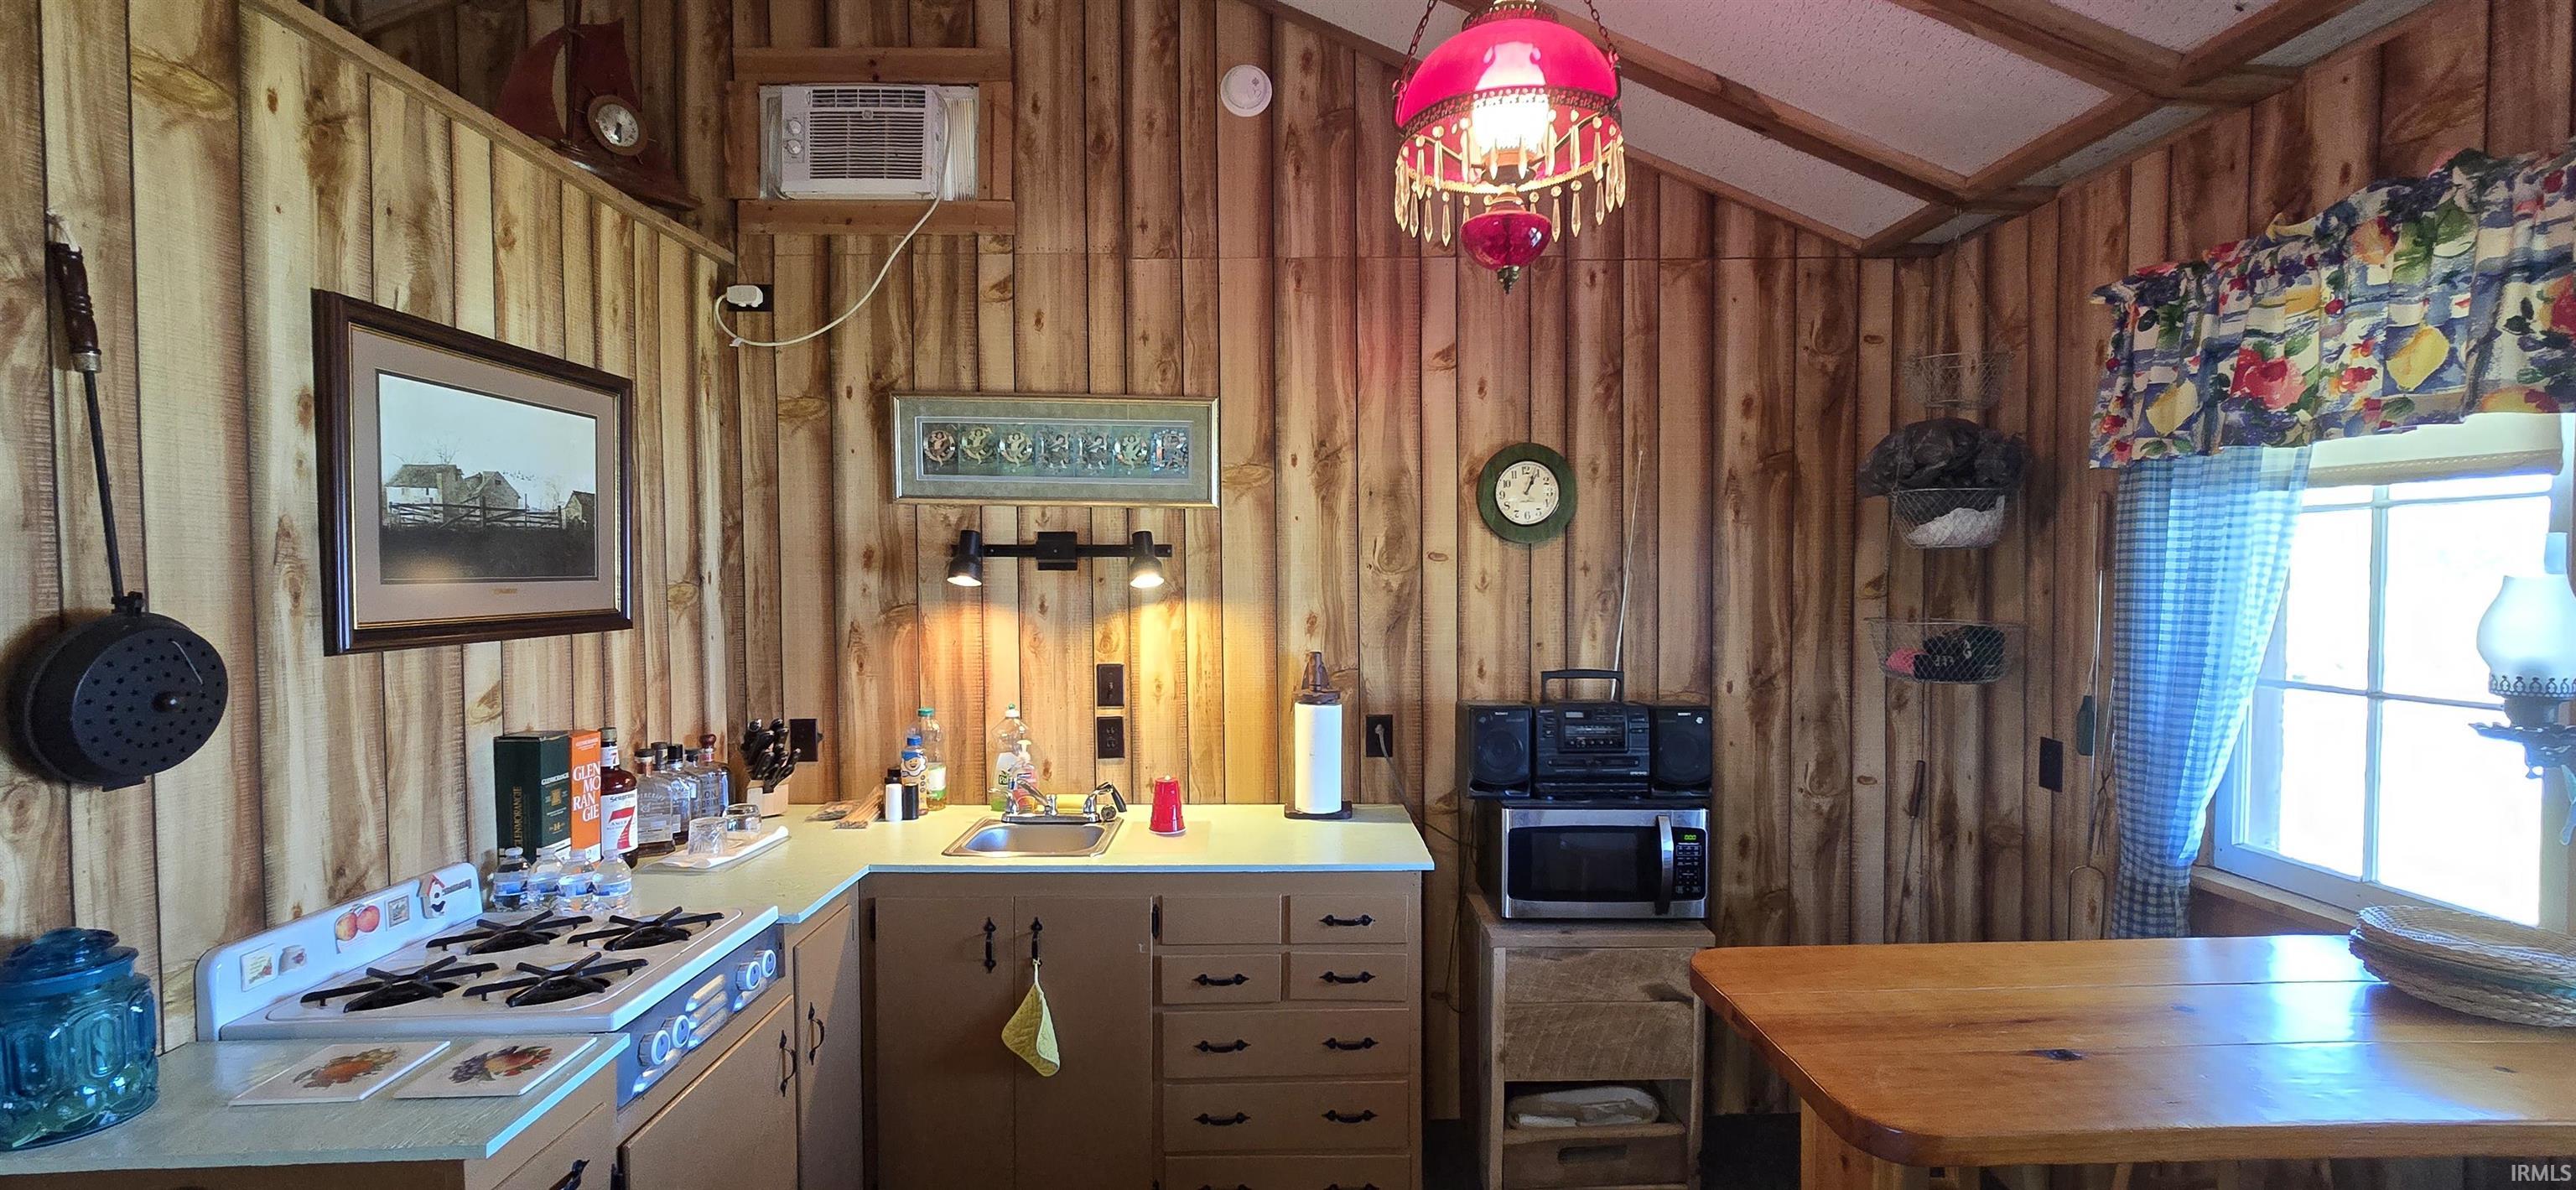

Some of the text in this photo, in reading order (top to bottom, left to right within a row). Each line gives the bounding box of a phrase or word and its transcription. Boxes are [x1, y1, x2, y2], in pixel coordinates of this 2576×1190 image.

[1521, 466, 1530, 475] 12
[1503, 480, 1511, 488] 10
[1543, 477, 1550, 486] 2
[1498, 491, 1506, 499] 9
[610, 752, 617, 765] 7
[573, 761, 601, 782] GLEN
[583, 776, 601, 793] MO
[573, 793, 595, 811] RAN
[582, 804, 600, 822] GIE
[608, 805, 636, 850] 7
